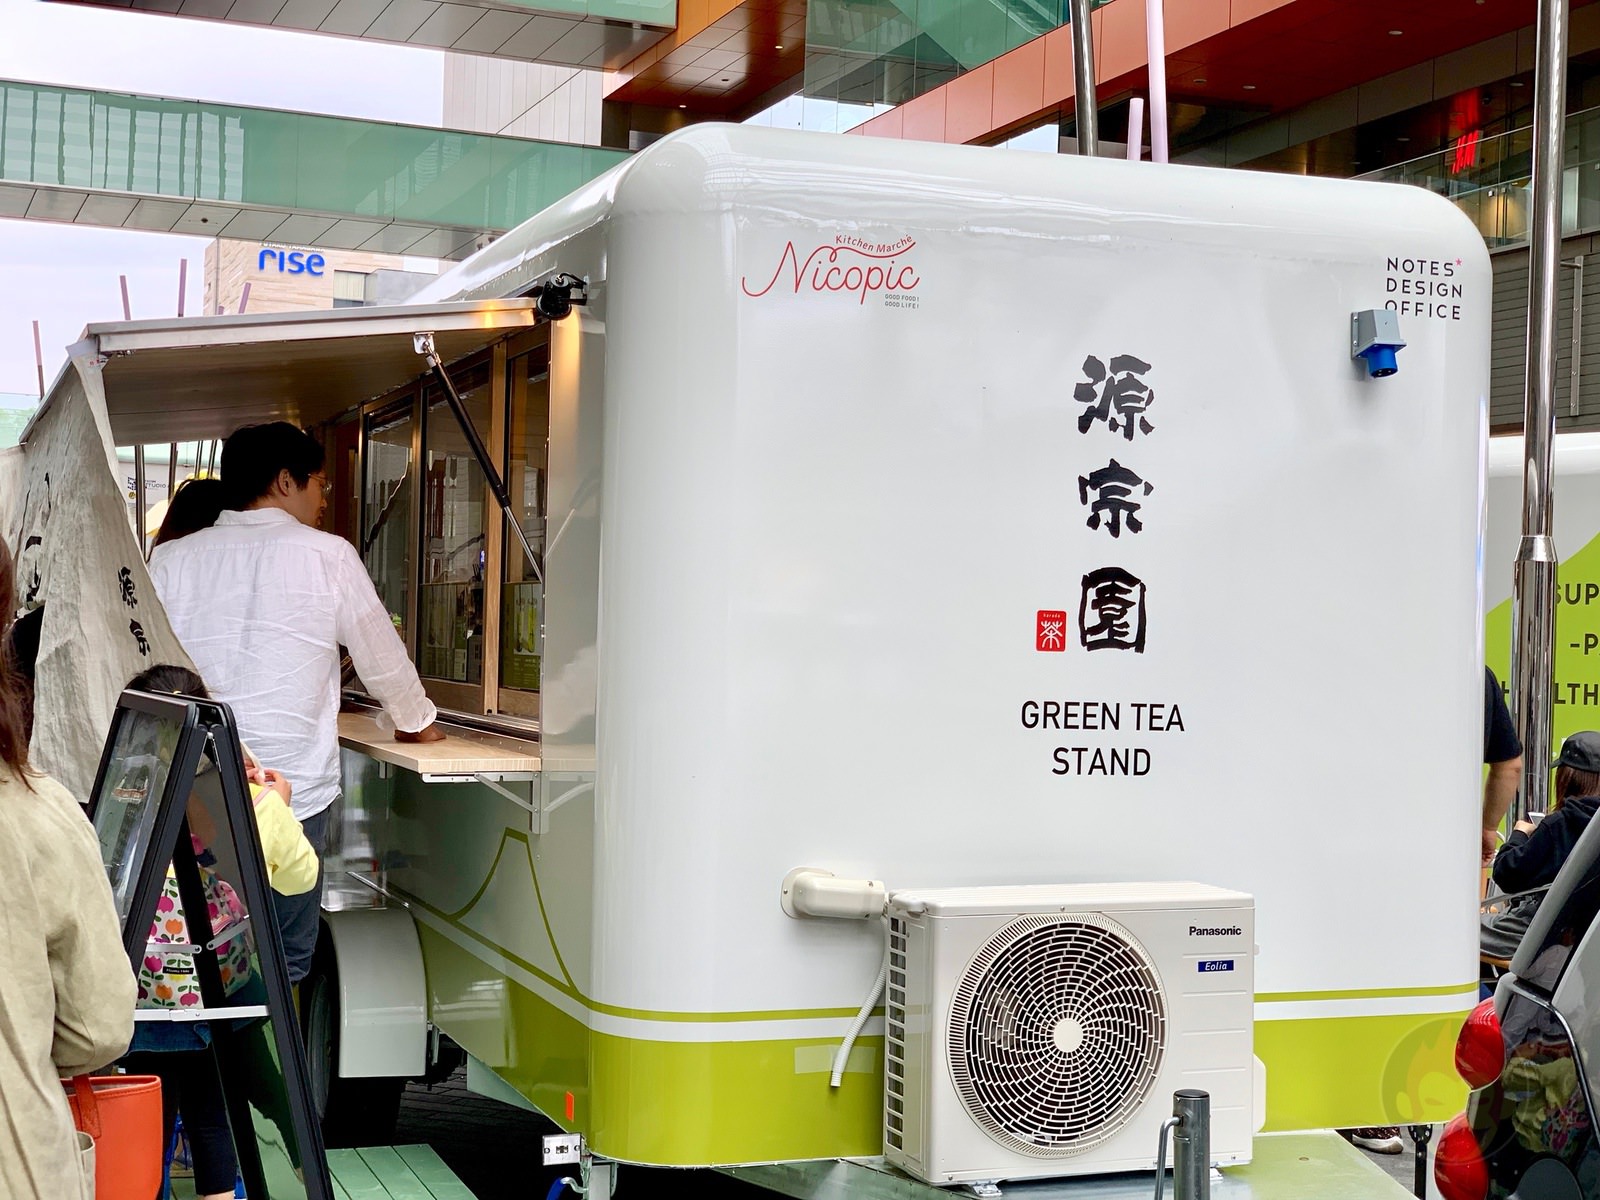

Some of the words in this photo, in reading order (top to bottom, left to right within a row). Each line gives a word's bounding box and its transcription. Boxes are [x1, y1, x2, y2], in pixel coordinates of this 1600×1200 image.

[836, 235, 874, 252] Kitchen
[259, 249, 325, 276] rise
[742, 241, 920, 304] Nicopic
[1387, 257, 1454, 277] NOTES
[1386, 277, 1462, 298] DESIGN
[1385, 300, 1461, 320] OFFICE
[1073, 354, 1155, 654] 源宗園
[1021, 700, 1120, 730] GREEN
[1130, 703, 1185, 732] TEA
[1052, 747, 1151, 776] STAND
[1189, 926, 1242, 936] Panasonic
[1204, 961, 1228, 971] Eolia
